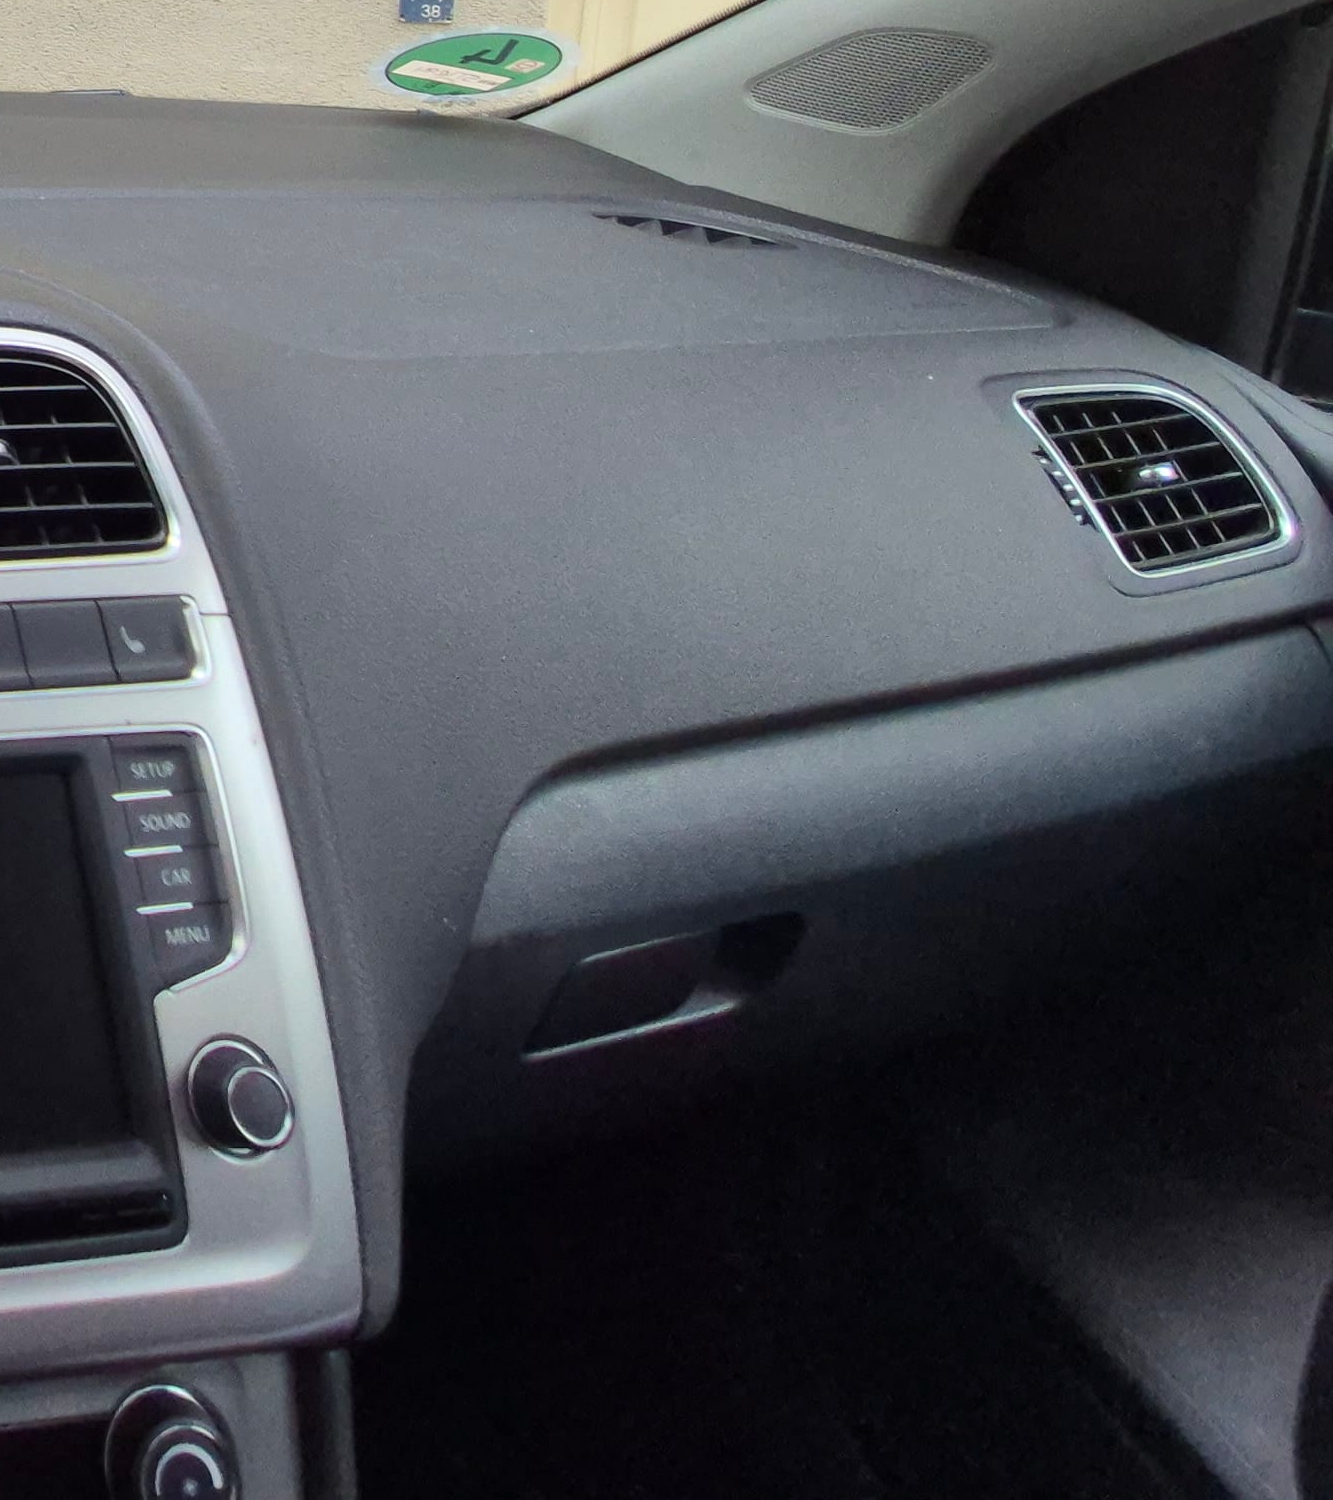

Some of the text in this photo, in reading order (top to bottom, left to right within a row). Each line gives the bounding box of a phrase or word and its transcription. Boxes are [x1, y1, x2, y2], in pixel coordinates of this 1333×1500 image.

[421, 4, 441, 18] 38
[130, 760, 177, 781] SETUP
[139, 812, 192, 832] SOUND
[161, 867, 192, 886] CAR
[165, 926, 211, 946] MENU
